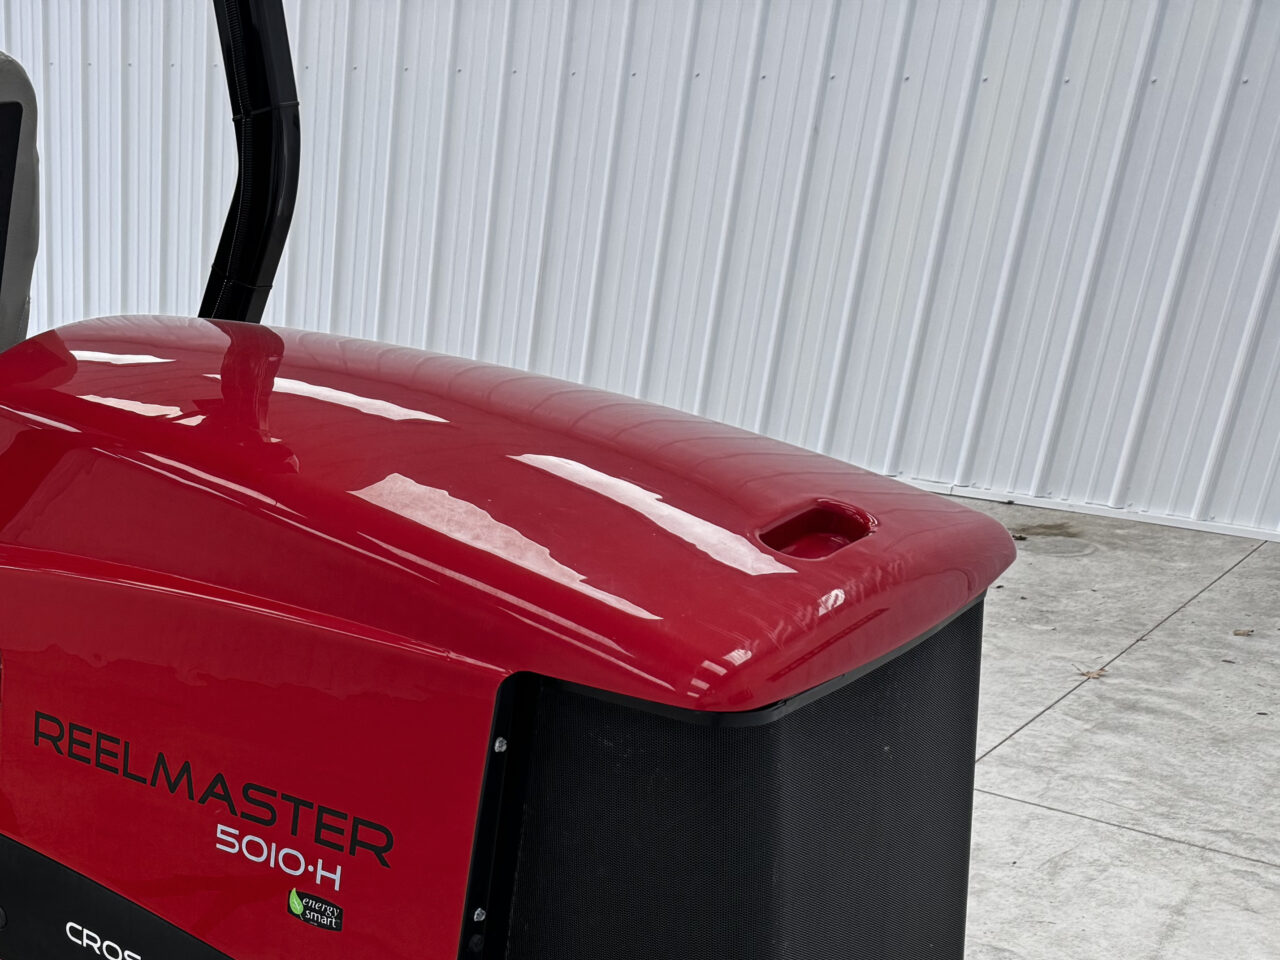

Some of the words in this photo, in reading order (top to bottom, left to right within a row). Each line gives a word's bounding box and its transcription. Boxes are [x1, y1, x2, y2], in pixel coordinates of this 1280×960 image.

[34, 711, 394, 868] REELMASTER
[302, 898, 339, 917] energy
[305, 910, 337, 928] smart
